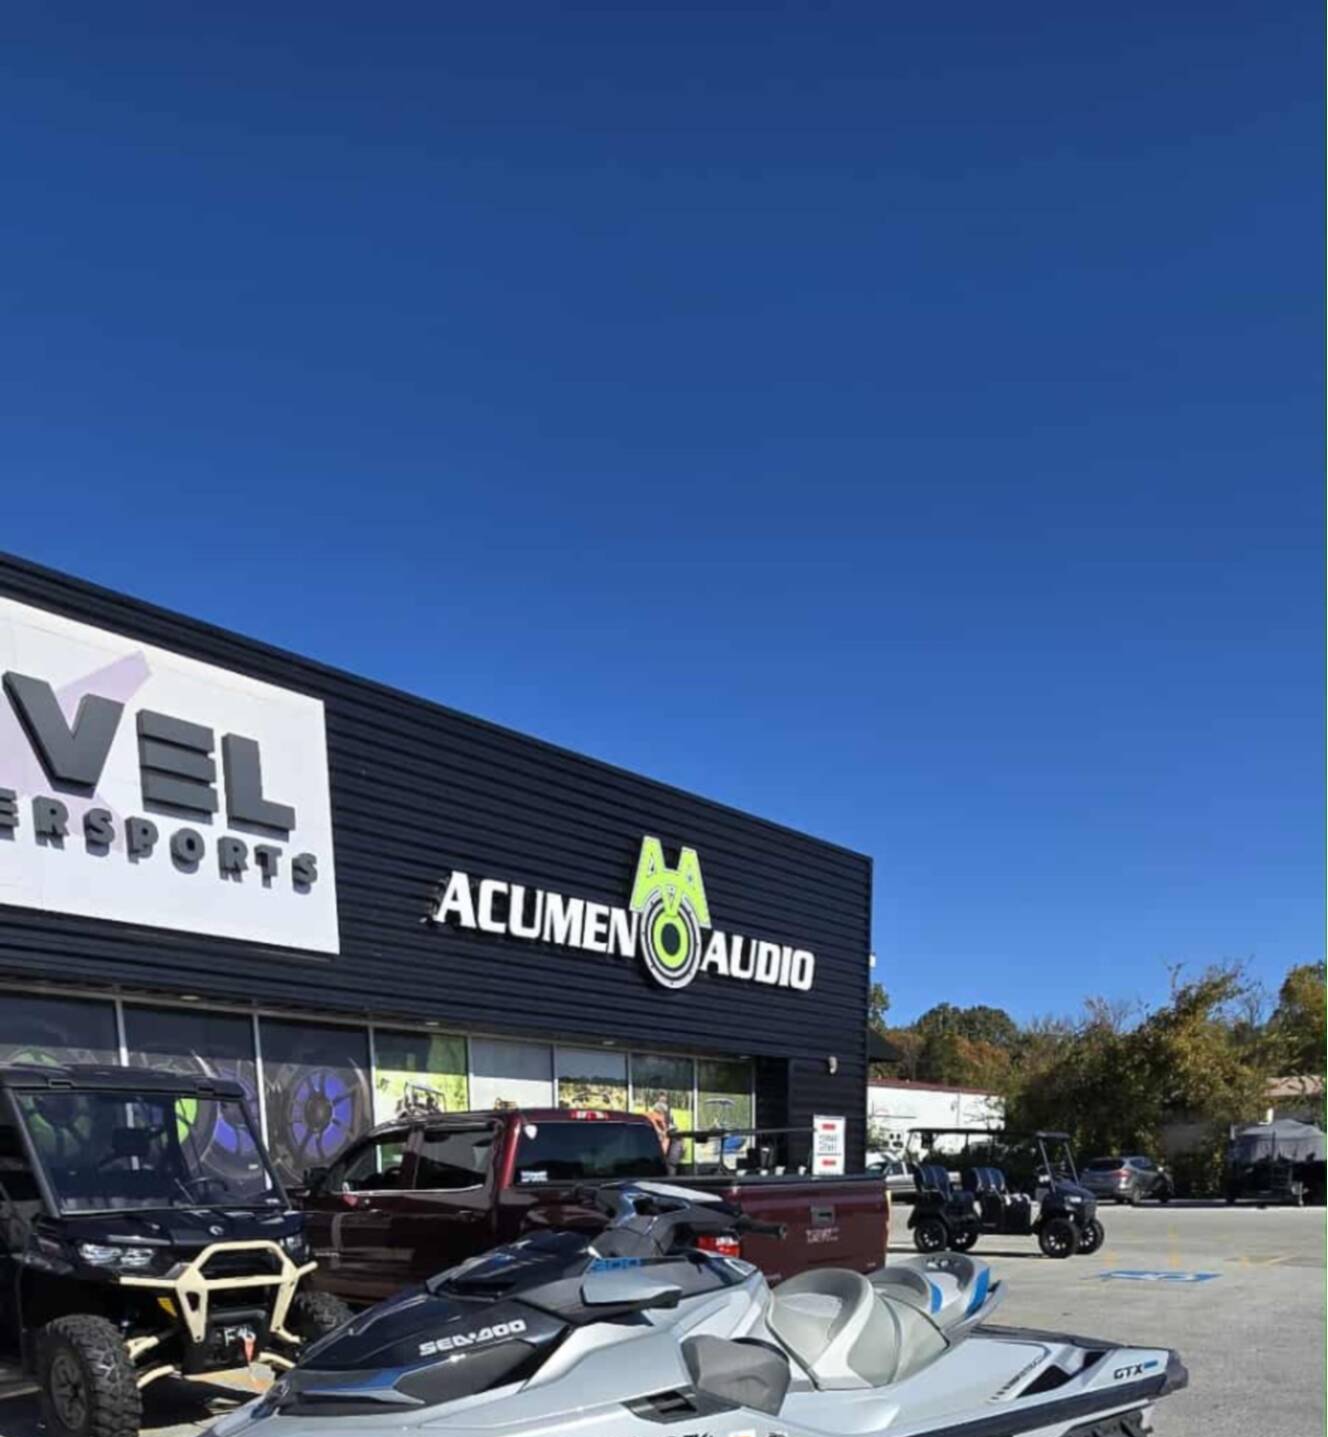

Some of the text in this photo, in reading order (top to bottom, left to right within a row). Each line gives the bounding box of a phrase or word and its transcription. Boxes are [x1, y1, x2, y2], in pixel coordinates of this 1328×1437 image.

[433, 871, 815, 991] ACUMEN AUDIO
[1113, 1363, 1143, 1380] GTX
